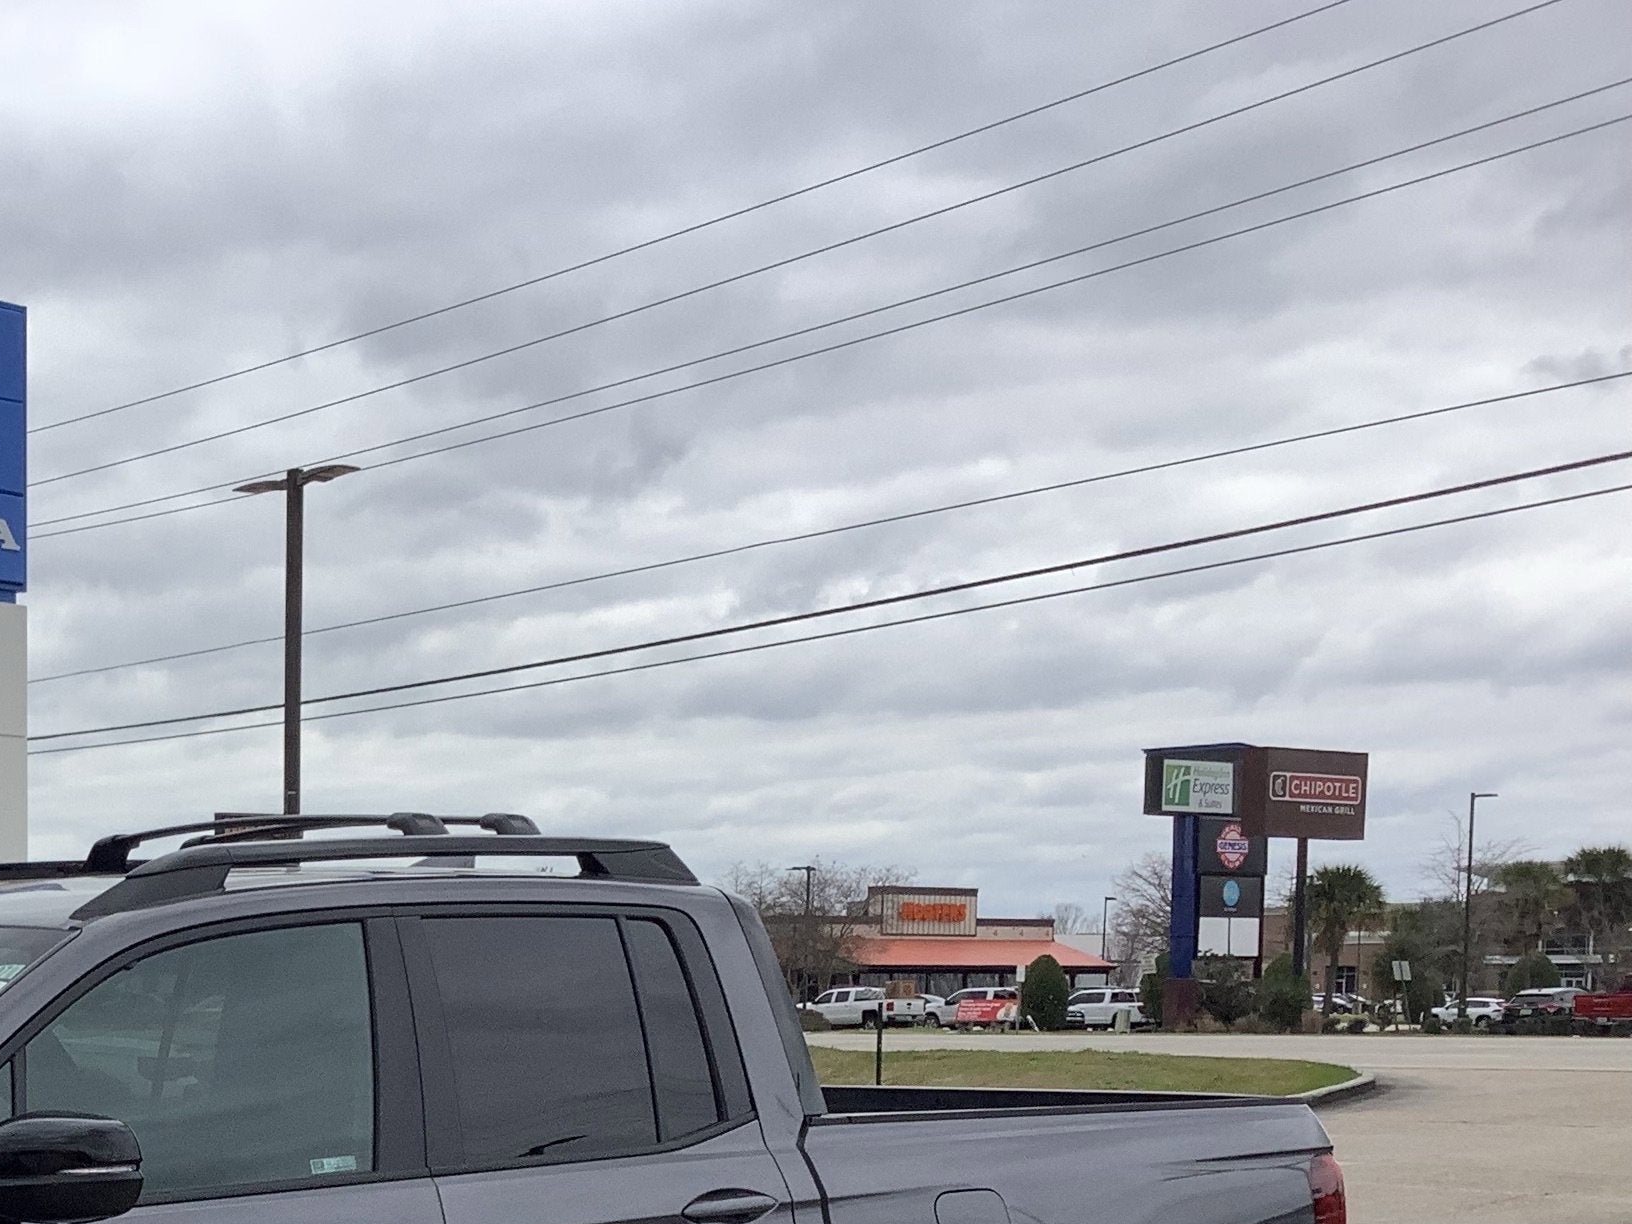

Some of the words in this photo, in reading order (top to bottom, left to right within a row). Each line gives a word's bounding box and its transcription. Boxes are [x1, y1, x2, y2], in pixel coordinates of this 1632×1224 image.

[1192, 778, 1231, 797] Express
[1291, 780, 1357, 798] CHIPOTLE
[1299, 804, 1333, 814] MEXICAN
[1334, 806, 1356, 815] GRILL
